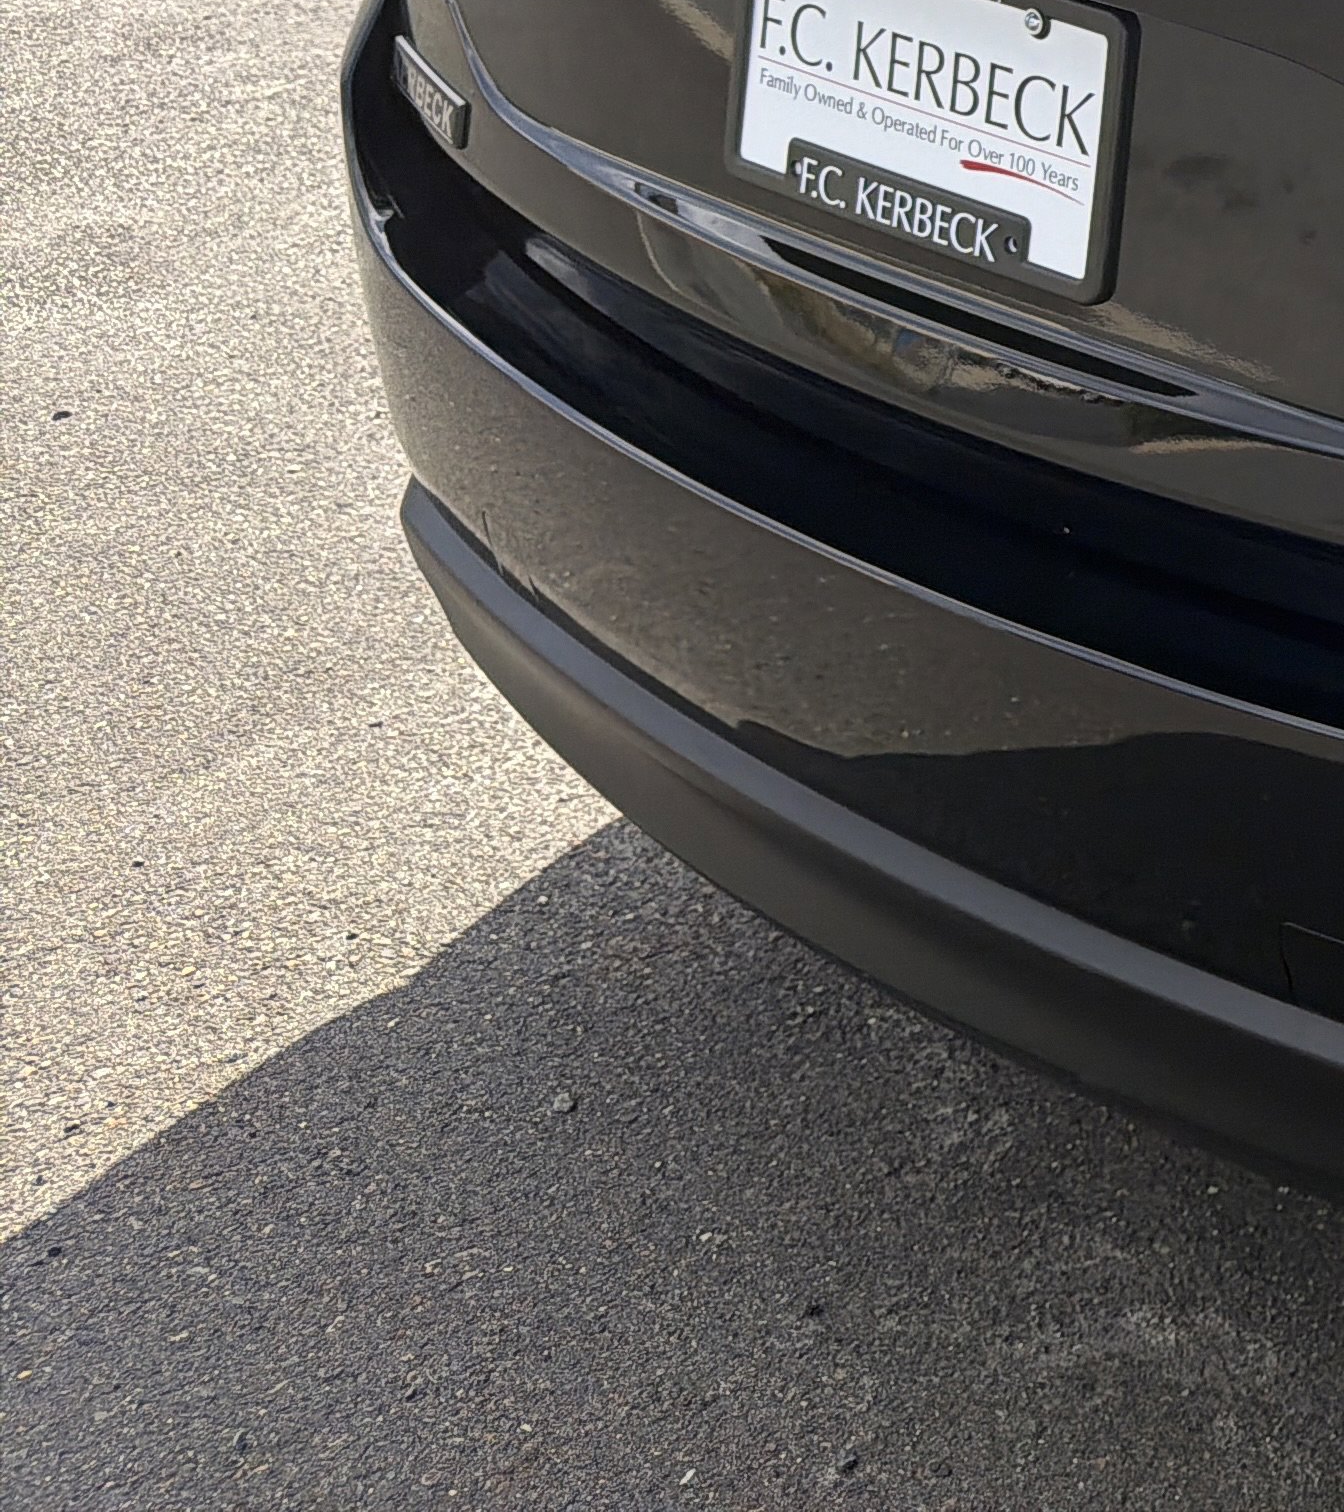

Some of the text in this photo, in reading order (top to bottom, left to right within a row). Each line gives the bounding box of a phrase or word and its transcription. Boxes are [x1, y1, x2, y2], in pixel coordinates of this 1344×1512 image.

[759, 67, 1079, 192] Family Owned & Operated For Over 100 Years
[852, 20, 1095, 157] KERBECK
[799, 156, 999, 263] F.C. KERBECK
